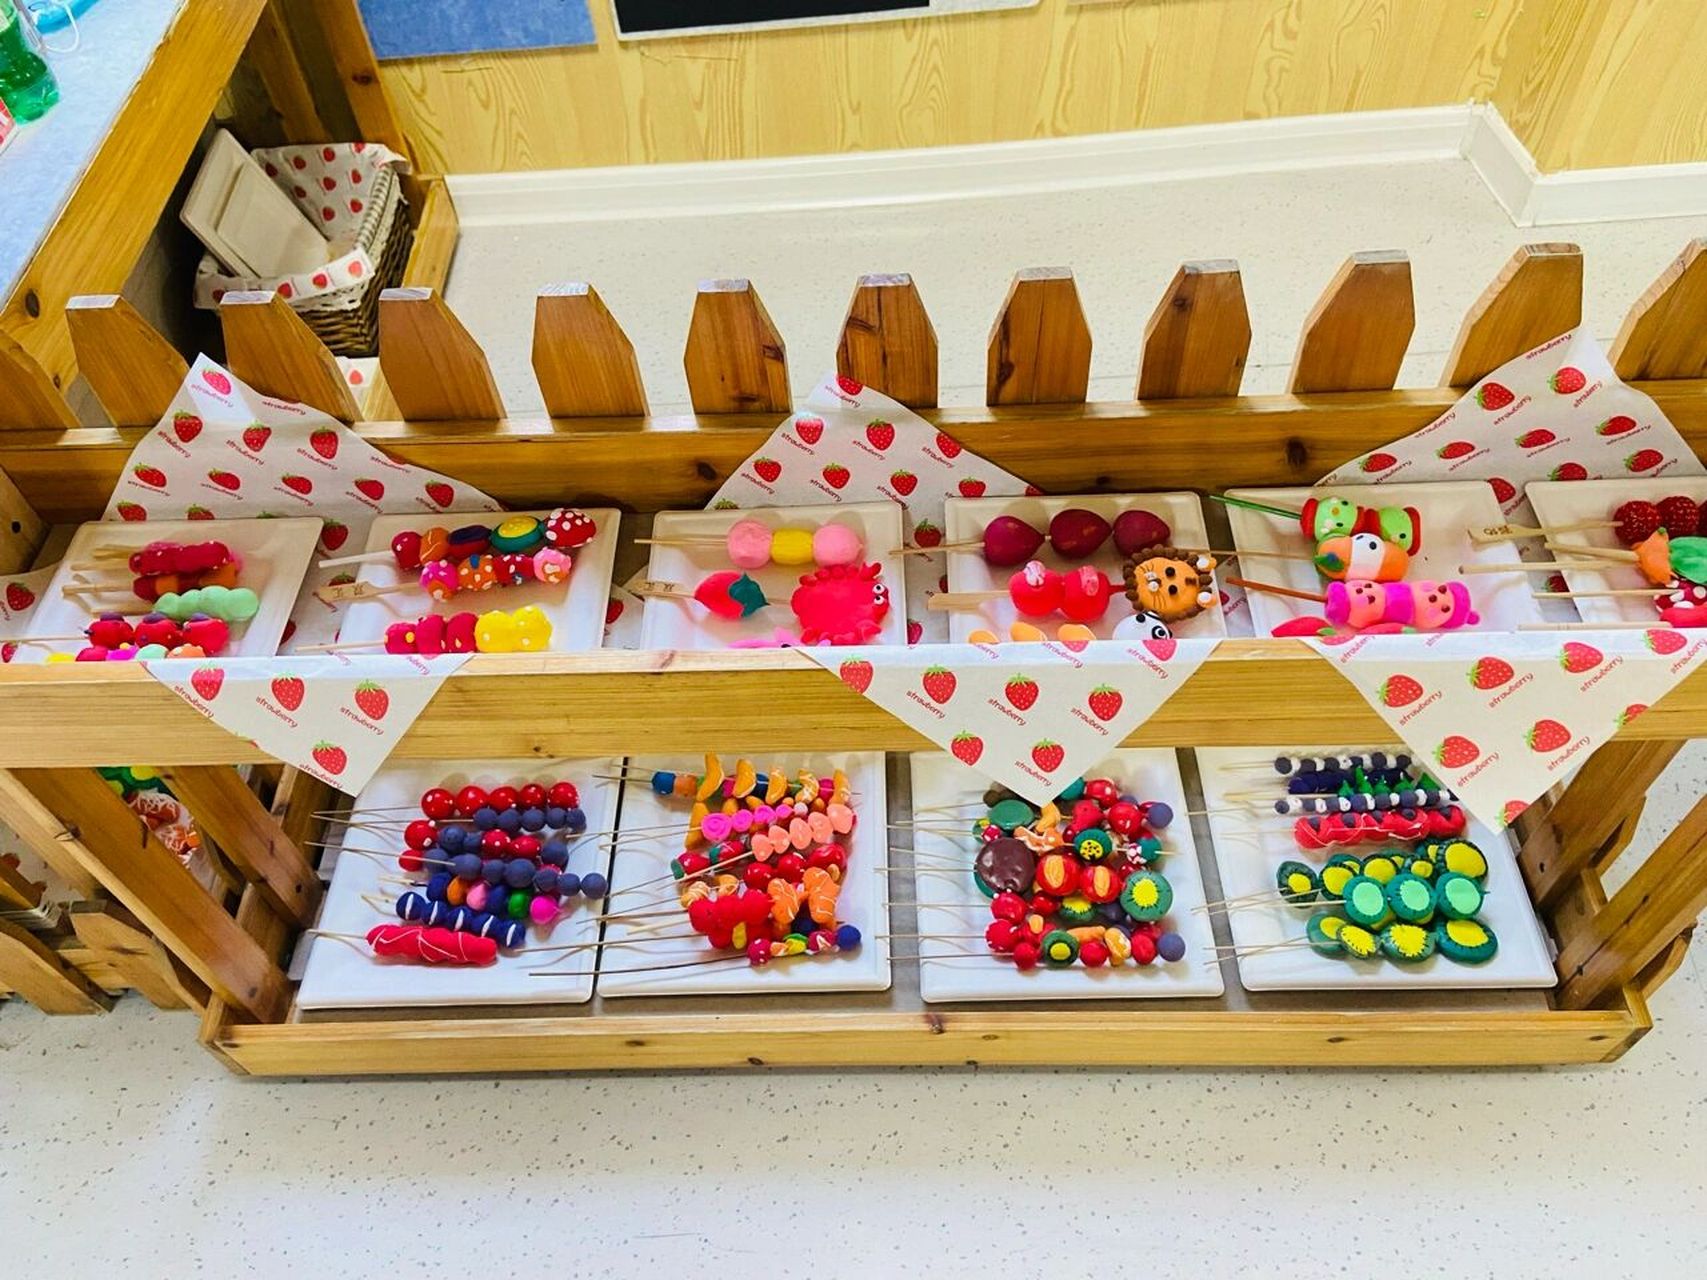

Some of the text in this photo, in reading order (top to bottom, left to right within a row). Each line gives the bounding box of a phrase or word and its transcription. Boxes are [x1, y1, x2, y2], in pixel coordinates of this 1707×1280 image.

[1525, 333, 1573, 360] strawberry
[190, 383, 234, 408] strawberry
[825, 384, 861, 408] strawberry
[1573, 380, 1603, 408] strawberry
[1493, 395, 1532, 425] strawberry
[1414, 412, 1456, 439] strawberry
[1606, 424, 1652, 446] strawberry
[226, 439, 265, 466] strawberry
[781, 432, 815, 456] strawberry
[852, 439, 887, 461] strawberry
[922, 446, 955, 469] strawberry
[296, 448, 338, 471] strawberry
[1448, 447, 1491, 472] strawberry
[273, 486, 314, 506] strawberry
[741, 472, 775, 495] strawberry
[810, 478, 842, 502] strawberry
[345, 491, 384, 514] strawberry
[1128, 648, 1169, 680] strawberry
[1580, 656, 1624, 693] strawberry
[174, 685, 214, 719] strawberry
[1488, 672, 1534, 708] strawberry
[256, 696, 298, 728] strawberry
[905, 690, 946, 719] strawberry
[987, 697, 1027, 726] strawberry
[1399, 690, 1443, 726] strawberry
[340, 706, 384, 736] strawberry
[1070, 707, 1109, 736] strawberry
[1548, 736, 1591, 772] strawberry
[299, 763, 343, 789] strawberry
[1014, 760, 1051, 787] strawberry
[1458, 751, 1500, 788] strawberry
